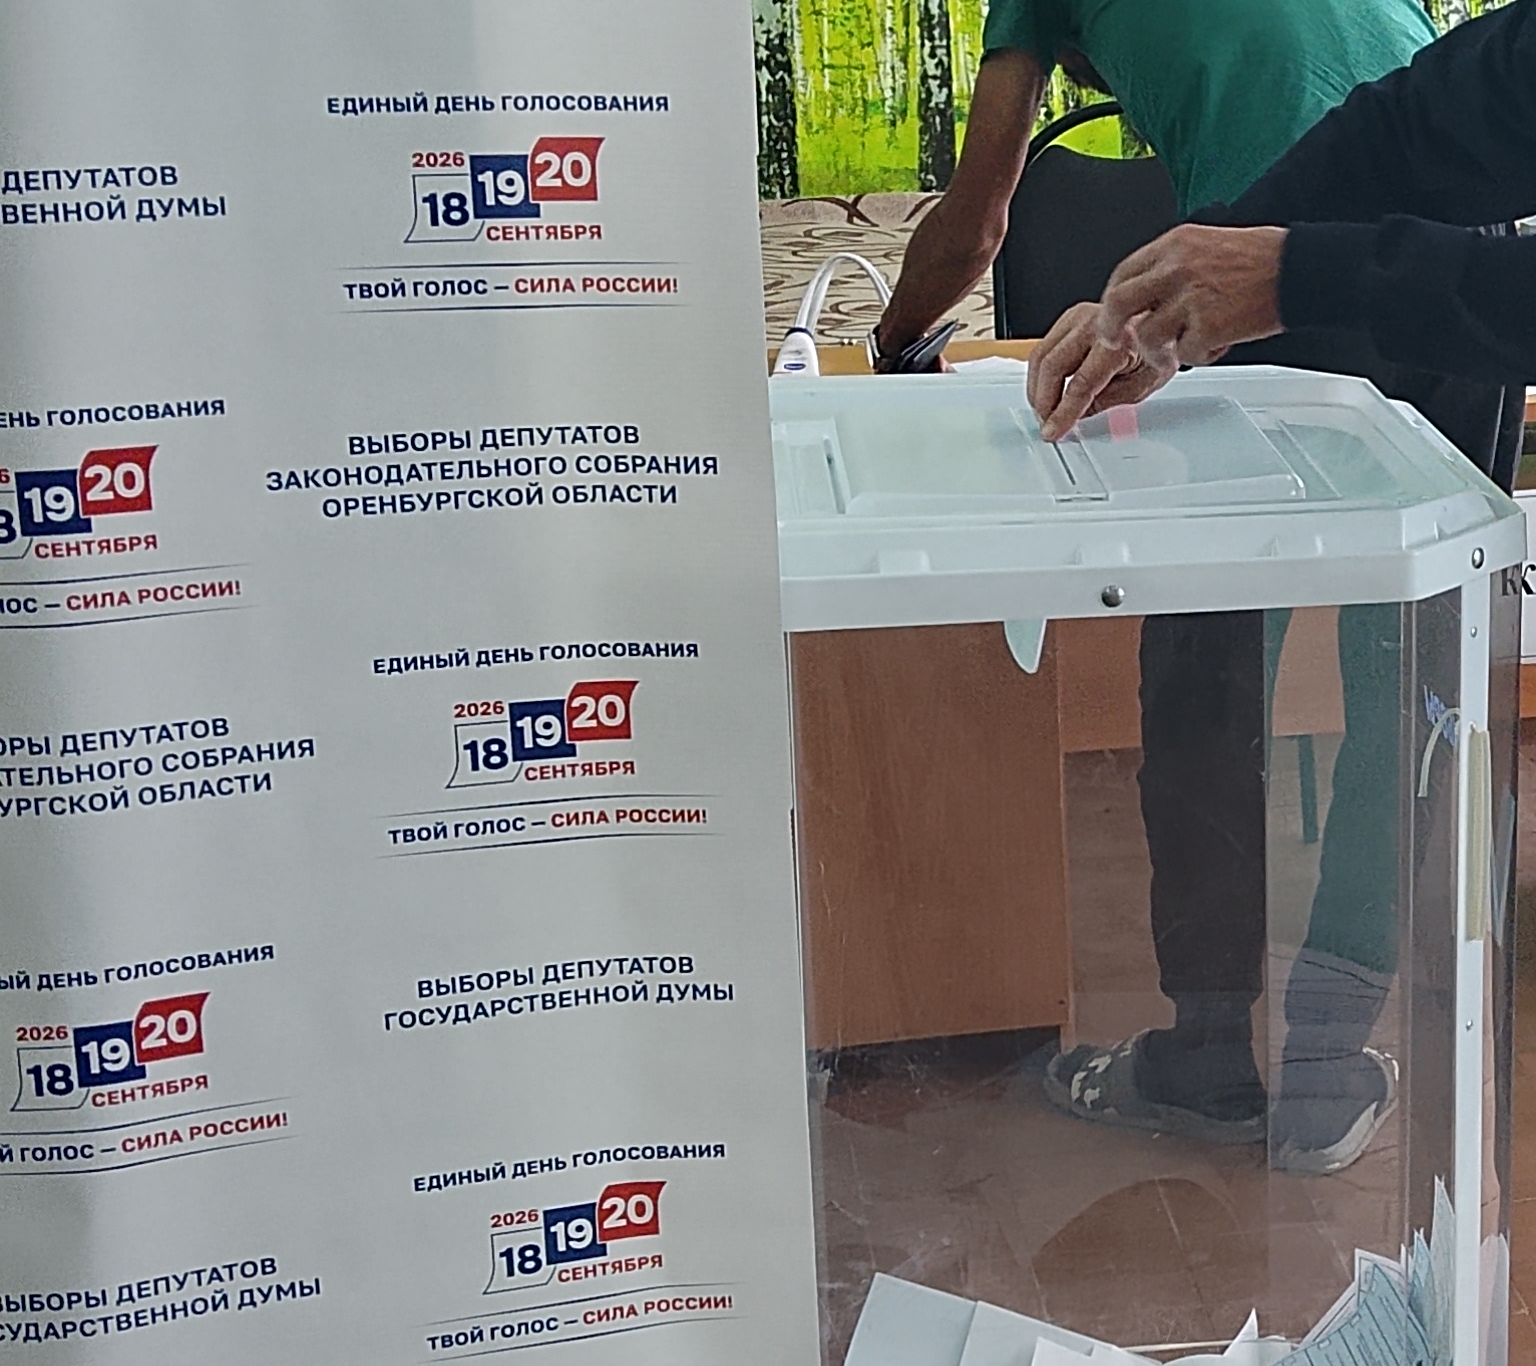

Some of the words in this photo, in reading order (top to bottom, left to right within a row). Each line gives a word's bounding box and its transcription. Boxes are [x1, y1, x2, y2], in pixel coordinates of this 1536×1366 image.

[327, 91, 429, 117] ЕДИНЫЙ
[434, 95, 495, 115] ДЕНЬ
[501, 95, 669, 112] ГОЛОСОВАНИЯ
[411, 151, 465, 168] 2026
[2, 166, 179, 194] ДЕПУТАТОВ
[421, 191, 470, 227] 18
[477, 170, 525, 206] 19
[534, 151, 590, 187] 20
[1, 194, 127, 225] ВЕННОЙ
[135, 196, 226, 223] ДУМЫ
[486, 224, 602, 242] СЕНТЯБРЯ
[342, 277, 407, 300] ТВОЙ
[412, 278, 488, 298] ГОЛОС
[514, 277, 576, 294] СИЛА
[581, 277, 678, 294] РОССИИ!
[46, 399, 225, 427] ГОЛОСОВАНИЯ
[348, 430, 471, 456] ВЫБОРЫ
[479, 425, 640, 452] ДЕПУТАТОВ
[266, 457, 567, 491] ЗАКОНОДАТЕЛЬНОГО
[575, 454, 718, 475] СОБРАНИЯ
[25, 484, 74, 523] 19
[83, 462, 145, 499] 20
[322, 481, 544, 518] ОРЕНБУРГСКОЙ
[552, 484, 677, 504] ОБЛАСТИ
[34, 534, 158, 559] СЕНТЯБРЯ
[66, 590, 132, 611] СИЛА
[137, 580, 241, 604] РОССИИ!
[373, 647, 470, 676] ЕДИНЫЙ
[475, 647, 534, 668] ДЕНЬ
[539, 642, 699, 661] ГОЛОСОВАНИЯ
[453, 700, 505, 719] 2026
[59, 717, 230, 758] ДЕПУТАТОВ
[462, 737, 509, 772] 18
[517, 715, 561, 749] 19
[570, 695, 626, 728] 20
[0, 757, 153, 787] ТЕЛЬНОГО
[161, 738, 315, 773] СОБРАНИЯ
[524, 760, 636, 781] СЕНТЯБРЯ
[138, 772, 272, 806] ОБЛАСТИ
[387, 821, 448, 845] ТВОЙ
[453, 816, 526, 839] ГОЛОС
[550, 810, 610, 828] СИЛА
[615, 808, 707, 824] РОССИИ!
[36, 970, 98, 992] ДЕНЬ
[103, 945, 274, 984] ГОЛОСОВАНИЯ
[417, 966, 534, 999] ВЫБОРЫ
[541, 956, 694, 986] ДЕПУТАТОВ
[384, 980, 648, 1030] ГОСУДАРСТВЕННОЙ
[655, 983, 734, 1004] ДУМЫ
[15, 1025, 69, 1042] 2026
[26, 1063, 74, 1098] 18
[82, 1036, 130, 1075] 19
[139, 1009, 198, 1048] 20
[91, 1074, 209, 1108] СЕНТЯБРЯ
[19, 1144, 95, 1163] ГОЛОС
[121, 1129, 184, 1153] СИЛА
[189, 1112, 288, 1141] РОССИИ!
[413, 1161, 506, 1193] ЕДИНЫЙ
[511, 1156, 567, 1180] ДЕНЬ
[572, 1143, 725, 1168] ГОЛОСОВАНИЯ
[490, 1208, 539, 1229] 2026
[498, 1243, 543, 1278] 18
[550, 1217, 593, 1252] 19
[602, 1194, 654, 1228] 20
[0, 1288, 108, 1313] ЫБОРЫ
[116, 1256, 277, 1306] ДЕПУТАТОВ
[557, 1254, 663, 1283] СЕНТЯБРЯ
[237, 1277, 321, 1311] ДУМЫ
[427, 1326, 485, 1350] ТВОЙ
[489, 1317, 559, 1341] ГОЛОС
[582, 1304, 639, 1325] СИЛА
[644, 1295, 733, 1315] РОССИИ!
